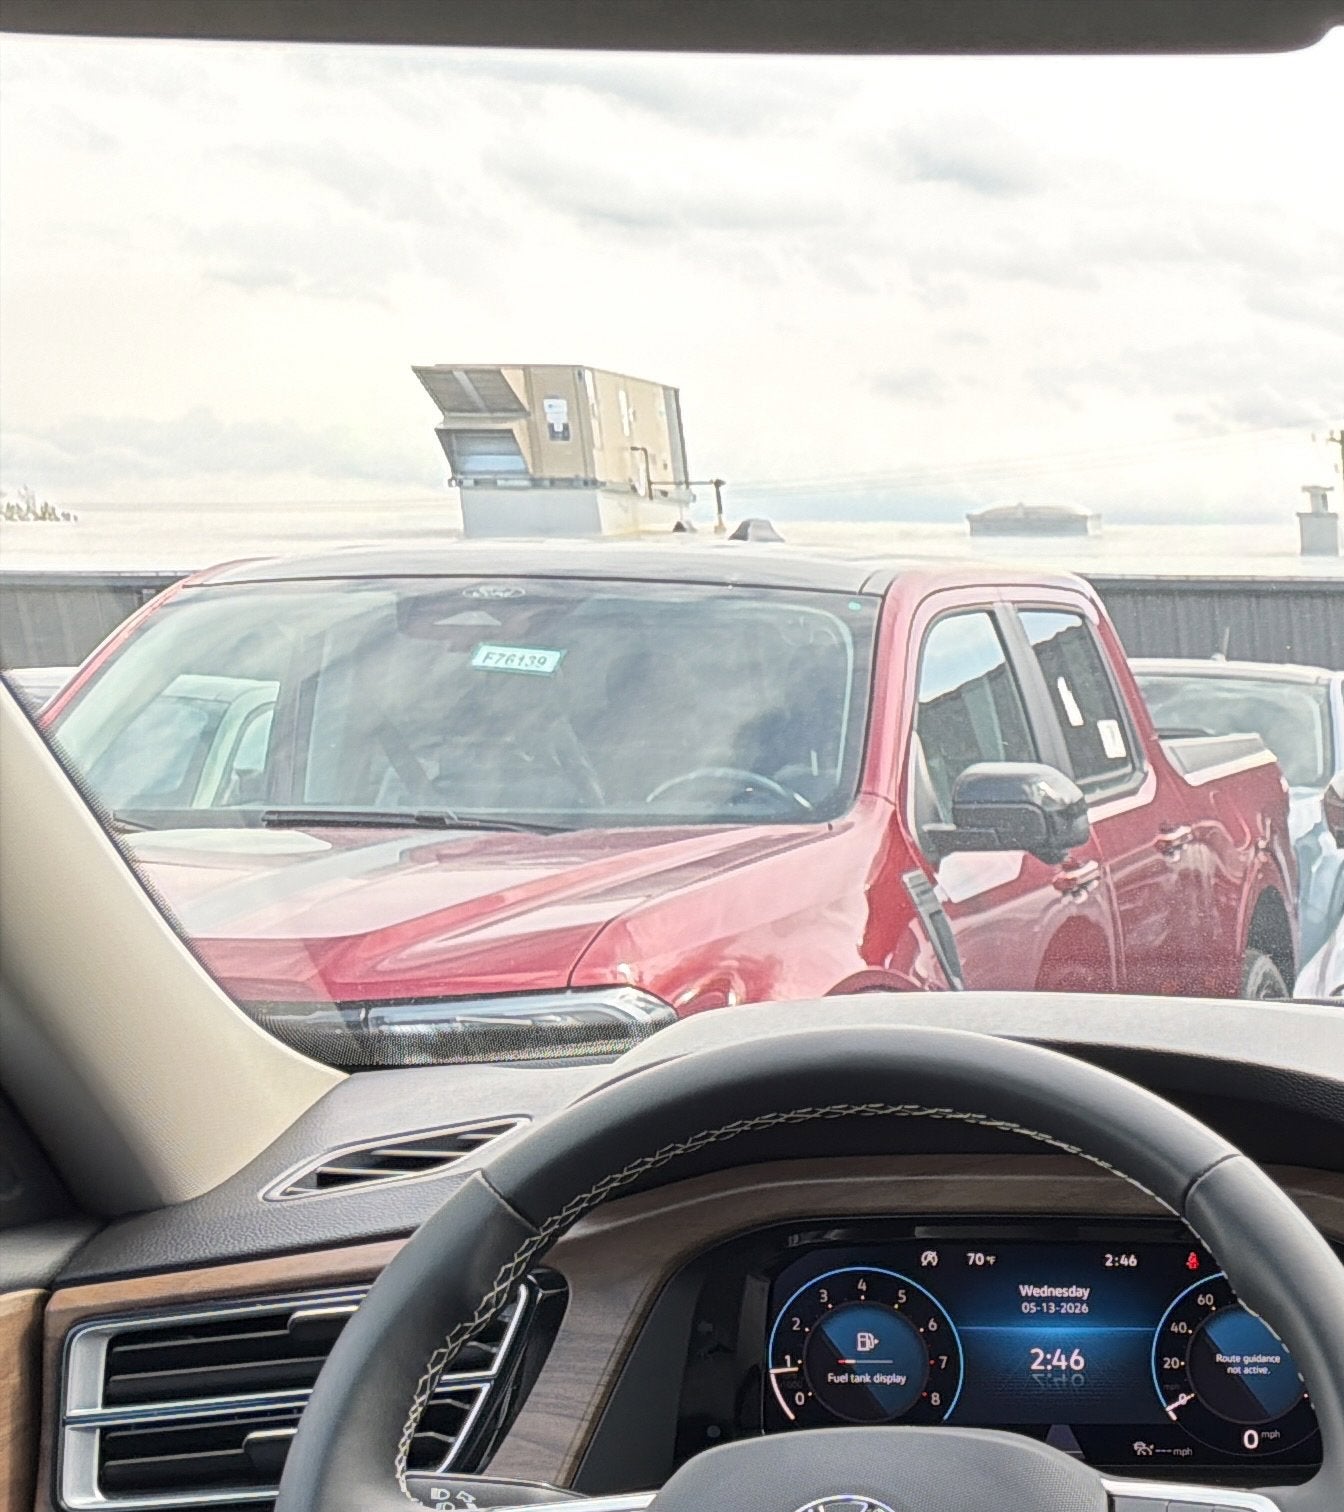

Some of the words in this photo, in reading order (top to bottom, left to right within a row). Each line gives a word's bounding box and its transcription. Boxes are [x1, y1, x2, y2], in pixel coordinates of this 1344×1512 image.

[1104, 1253, 1138, 1267] 2:46
[857, 1278, 867, 1292] 4
[819, 1289, 829, 1302] 3
[897, 1290, 906, 1302] 5
[1019, 1284, 1090, 1300] Wednesday
[1197, 1293, 1214, 1306] 60
[1021, 1302, 1090, 1314] 05-13-2026
[791, 1318, 801, 1331] 2
[928, 1318, 937, 1331] 6
[1170, 1321, 1187, 1334] 40
[784, 1354, 791, 1367] 1
[938, 1355, 948, 1369] 7
[1030, 1347, 1086, 1371] 2:46
[1163, 1357, 1179, 1370] 20
[1215, 1354, 1241, 1364] Route
[1243, 1354, 1281, 1366] guidance
[1227, 1365, 1242, 1375] not
[827, 1372, 849, 1384] Fuel
[850, 1372, 872, 1384] tank
[873, 1372, 906, 1386] display
[794, 1392, 805, 1406] 0
[931, 1393, 941, 1405] 8
[1243, 1429, 1259, 1449] 0
[1261, 1430, 1281, 1440] mph
